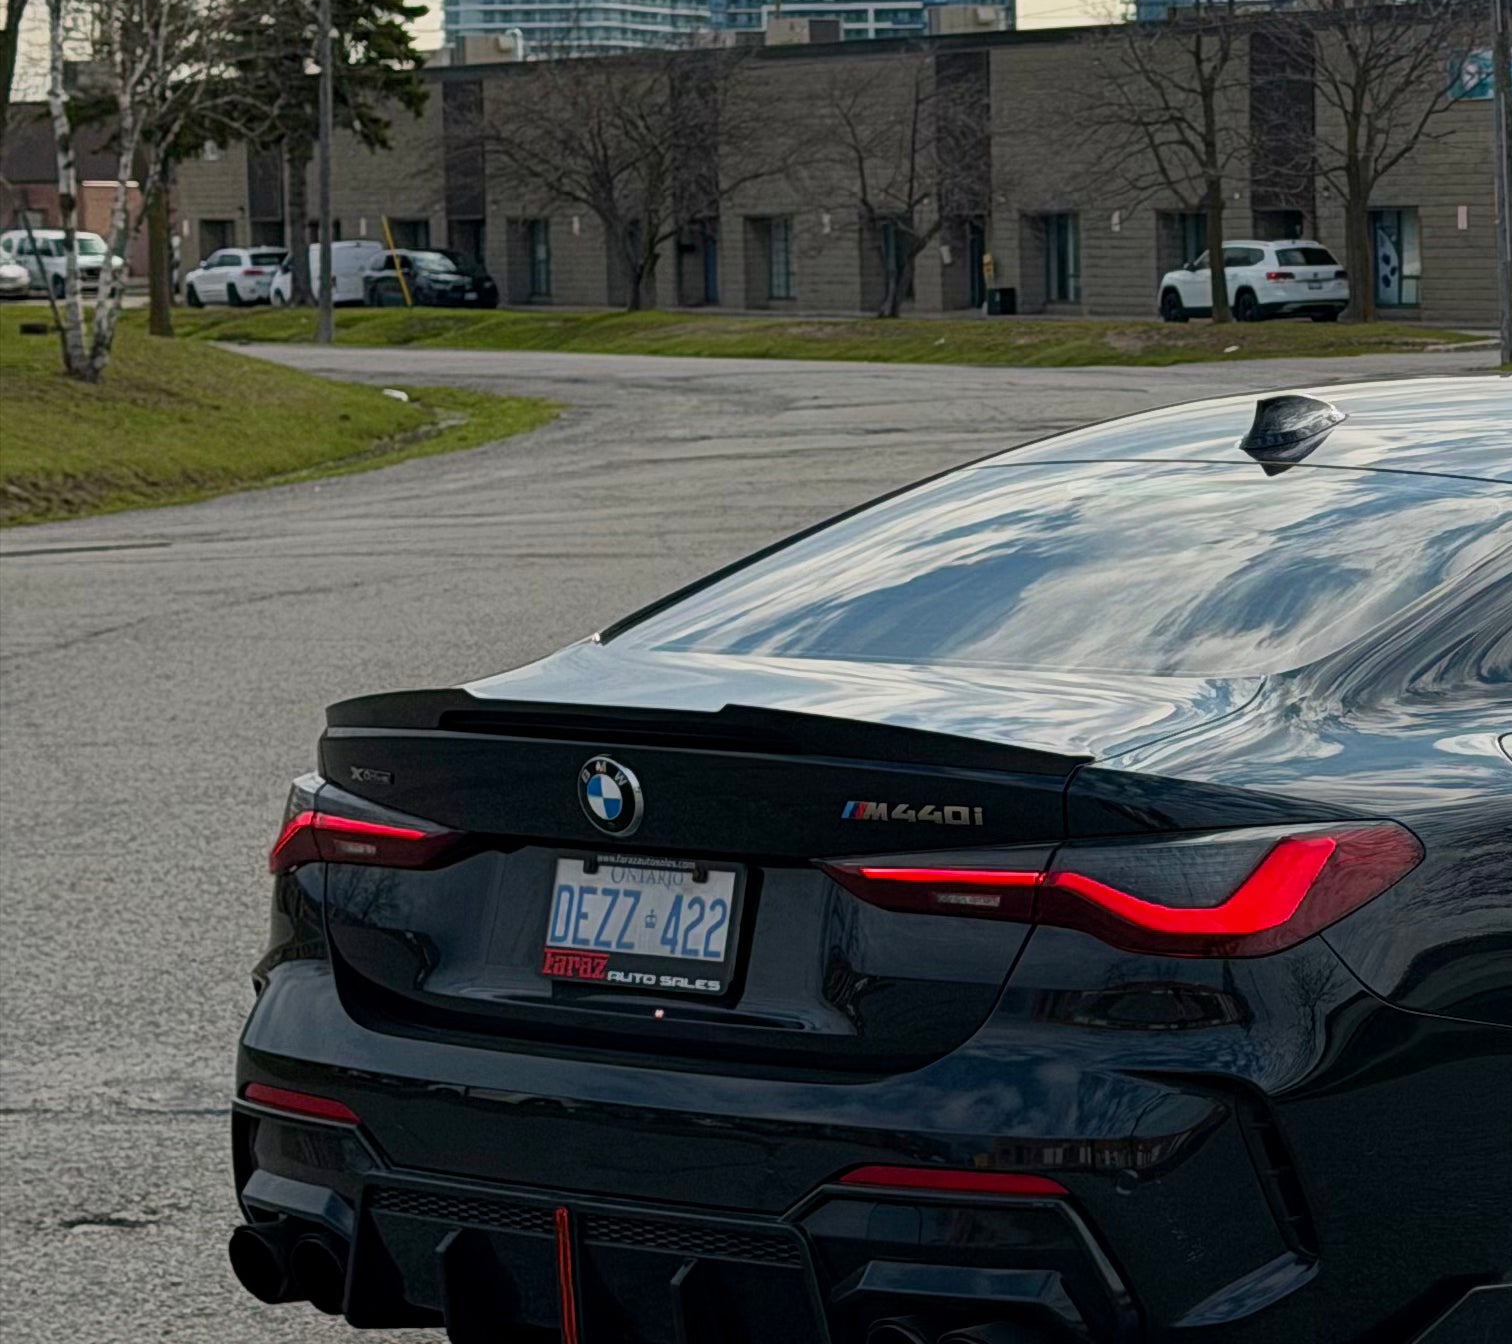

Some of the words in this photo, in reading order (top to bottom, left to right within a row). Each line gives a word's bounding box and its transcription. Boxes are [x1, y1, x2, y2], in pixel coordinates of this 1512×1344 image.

[581, 760, 628, 786] BMW
[862, 801, 984, 826] M440i
[550, 884, 642, 950] DEZZ
[660, 894, 728, 958] 422
[607, 970, 656, 987] AUTO
[659, 975, 721, 992] SALES
